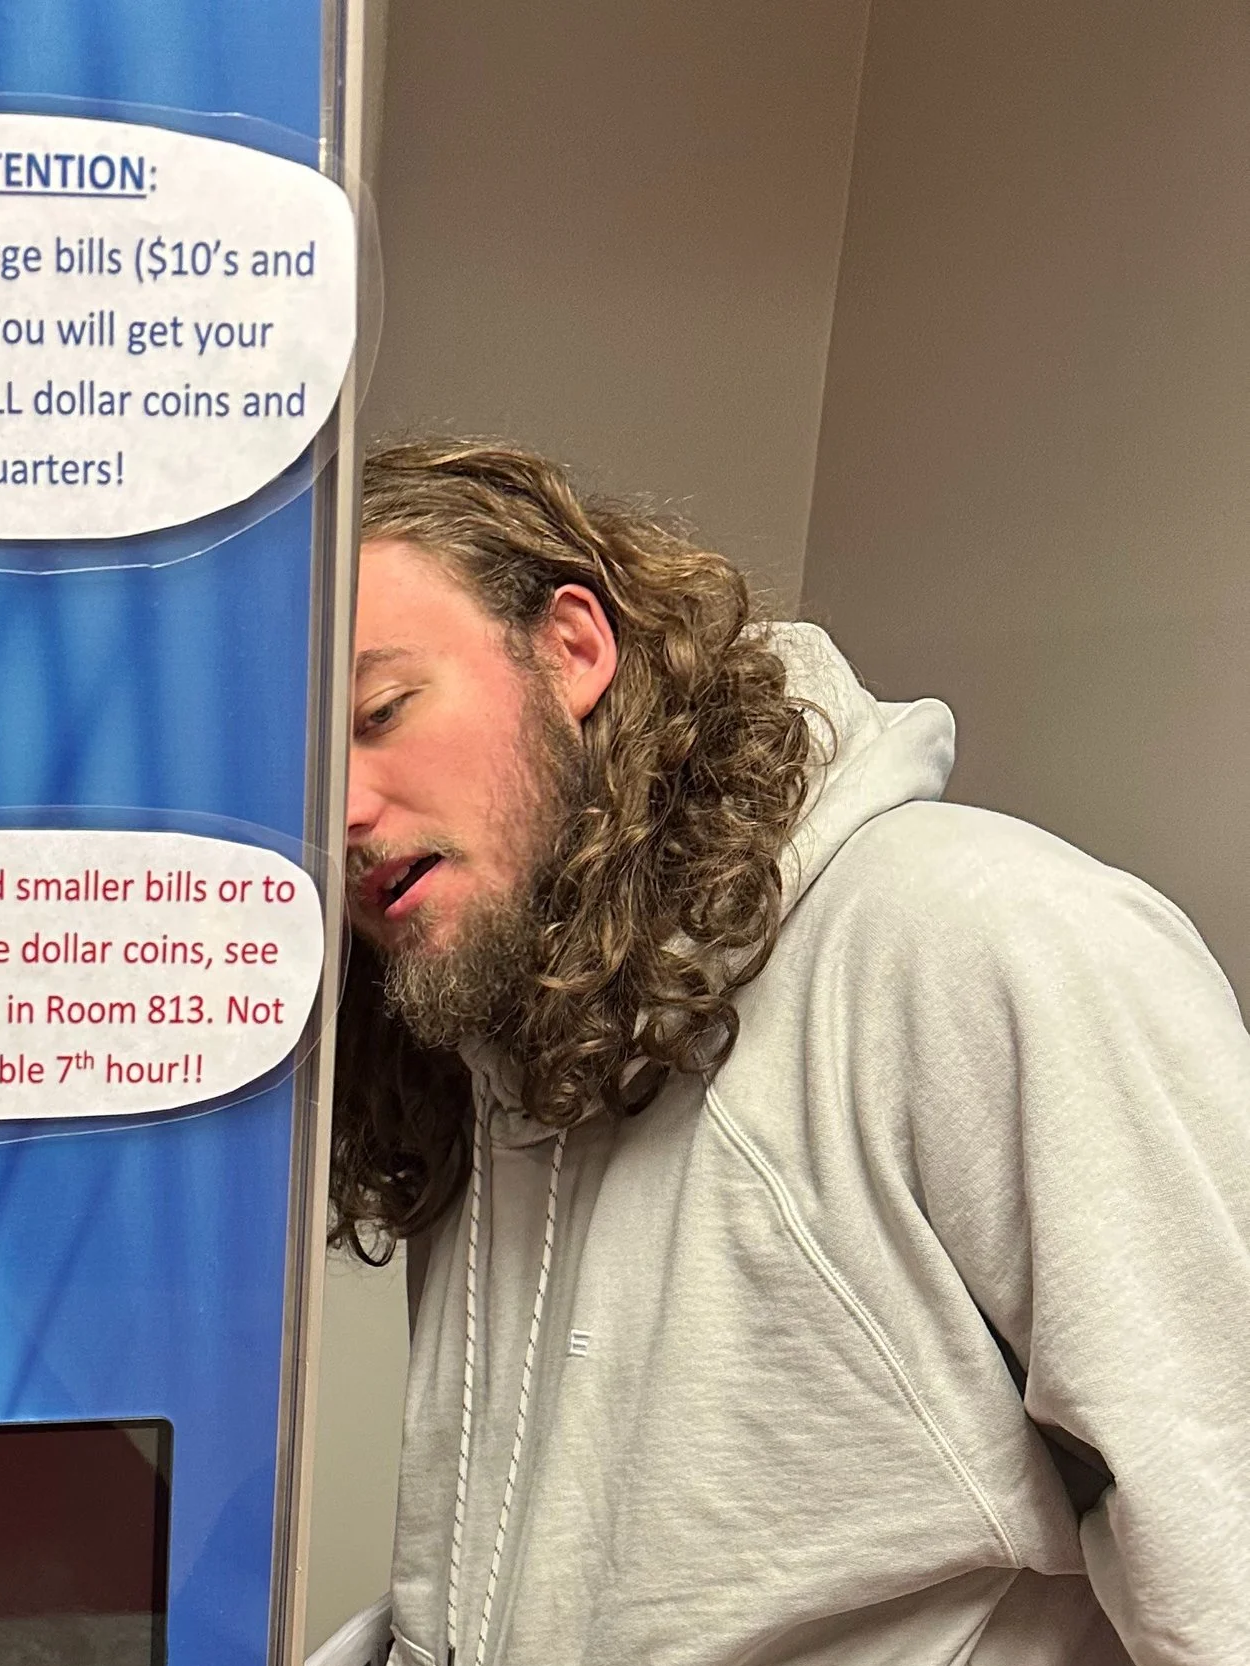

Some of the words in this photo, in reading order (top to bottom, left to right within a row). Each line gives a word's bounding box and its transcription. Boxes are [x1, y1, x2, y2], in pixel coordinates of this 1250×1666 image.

[56, 236, 122, 275] bills
[251, 241, 315, 277] and
[57, 310, 114, 346] will
[127, 316, 183, 356] get
[194, 322, 274, 356] your
[33, 380, 132, 416] dollar
[143, 383, 230, 417] coins
[243, 382, 306, 417] and
[16, 869, 135, 902] smaller
[145, 869, 207, 903] bills
[218, 879, 253, 903] or
[262, 875, 296, 904] to
[21, 932, 113, 964] dollar
[123, 934, 213, 970] coins,
[224, 942, 279, 965] see
[7, 994, 34, 1024] in
[46, 995, 136, 1025] Room
[147, 994, 213, 1025] 813.
[227, 995, 285, 1025] Not
[106, 1053, 202, 1084] hour!!
